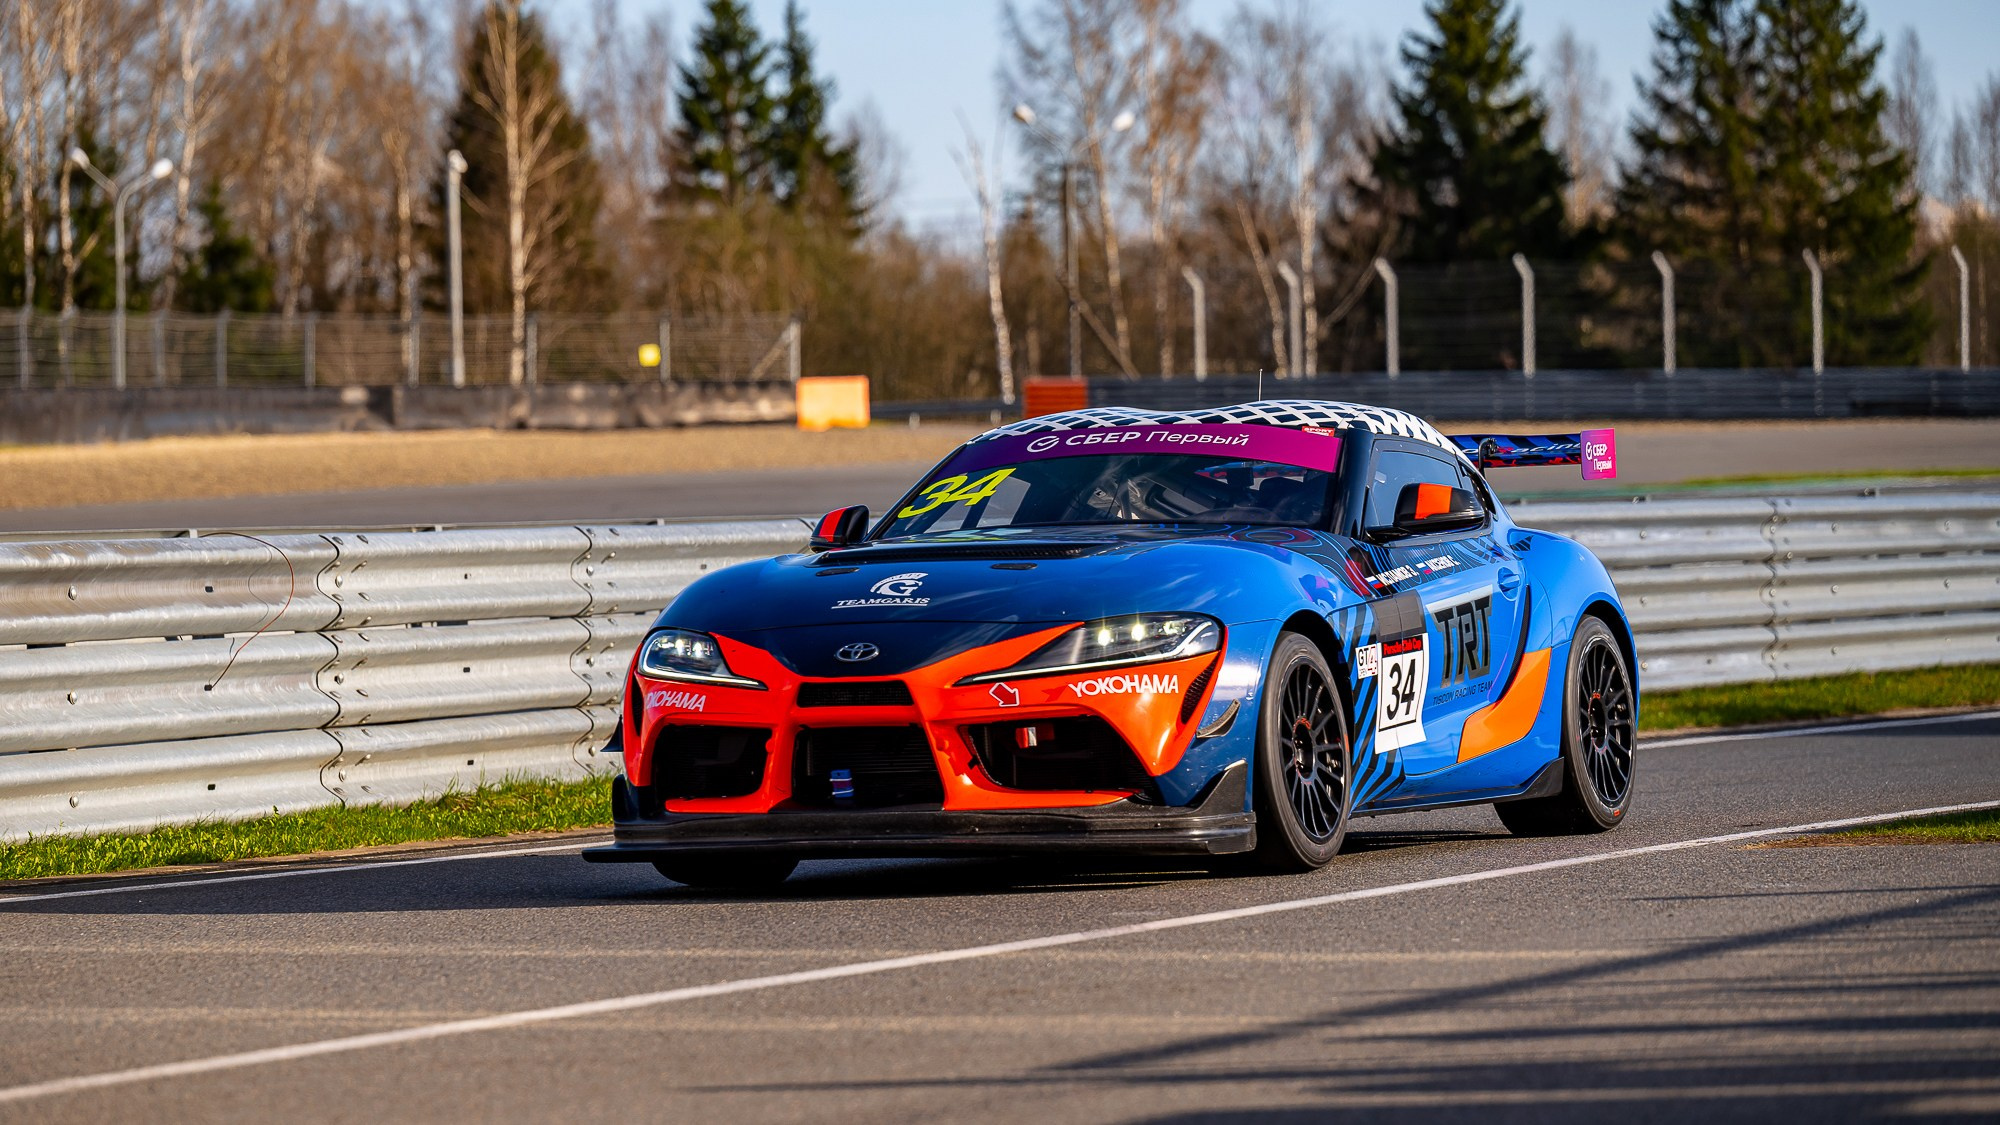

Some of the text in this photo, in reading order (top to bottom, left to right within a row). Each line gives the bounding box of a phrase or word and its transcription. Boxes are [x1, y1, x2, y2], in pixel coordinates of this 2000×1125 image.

[1065, 431, 1250, 446] СБЕР Первый
[1593, 444, 1607, 456] СБЕР
[1593, 457, 1612, 472] Первый
[898, 468, 1015, 518] 34
[836, 597, 931, 607] TEAMGARIS
[1429, 591, 1493, 686] TRT
[1068, 674, 1179, 697] YOKOHAMA
[1386, 658, 1416, 721] 34
[1454, 685, 1476, 699] RACING
[1477, 680, 1494, 692] TEAM
